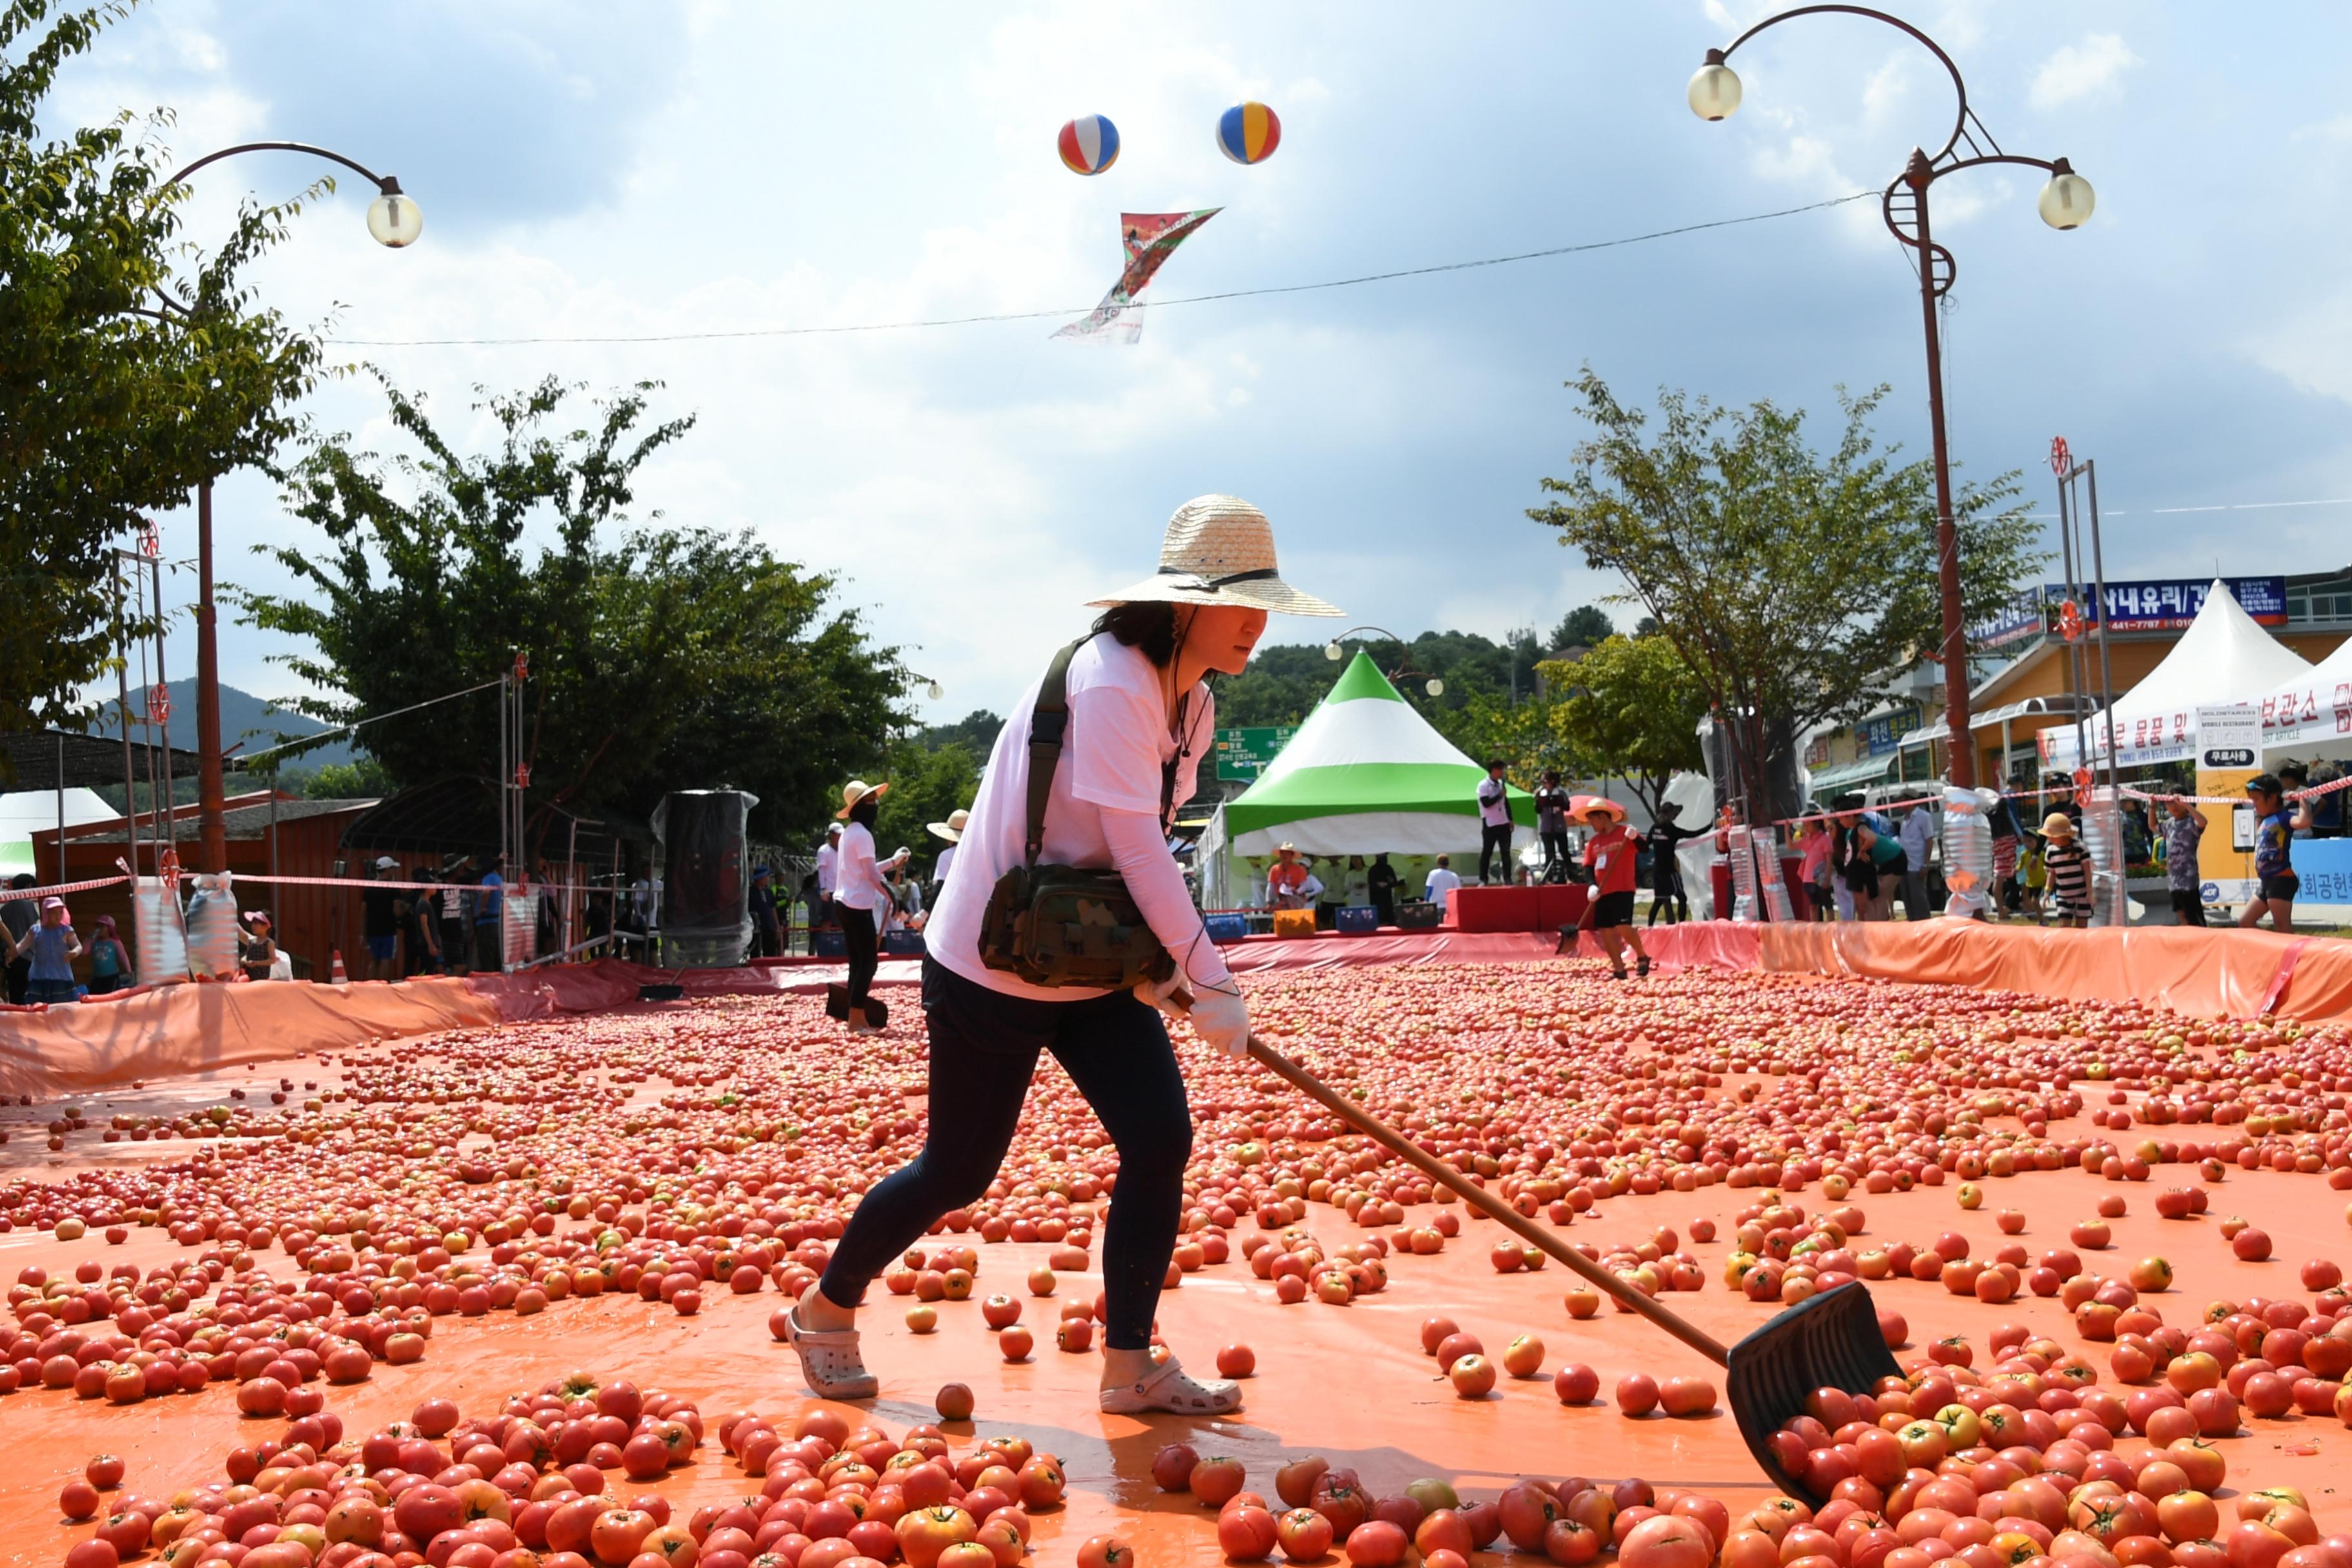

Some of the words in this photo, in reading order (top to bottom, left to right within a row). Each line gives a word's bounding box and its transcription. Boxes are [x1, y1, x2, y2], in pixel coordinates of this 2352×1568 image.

[2135, 716, 2163, 749] 물품
[2173, 712, 2187, 744] 및
[2262, 689, 2319, 729] 보관소
[2275, 729, 2300, 742] ARTICLE
[2211, 750, 2248, 762] 무료사용
